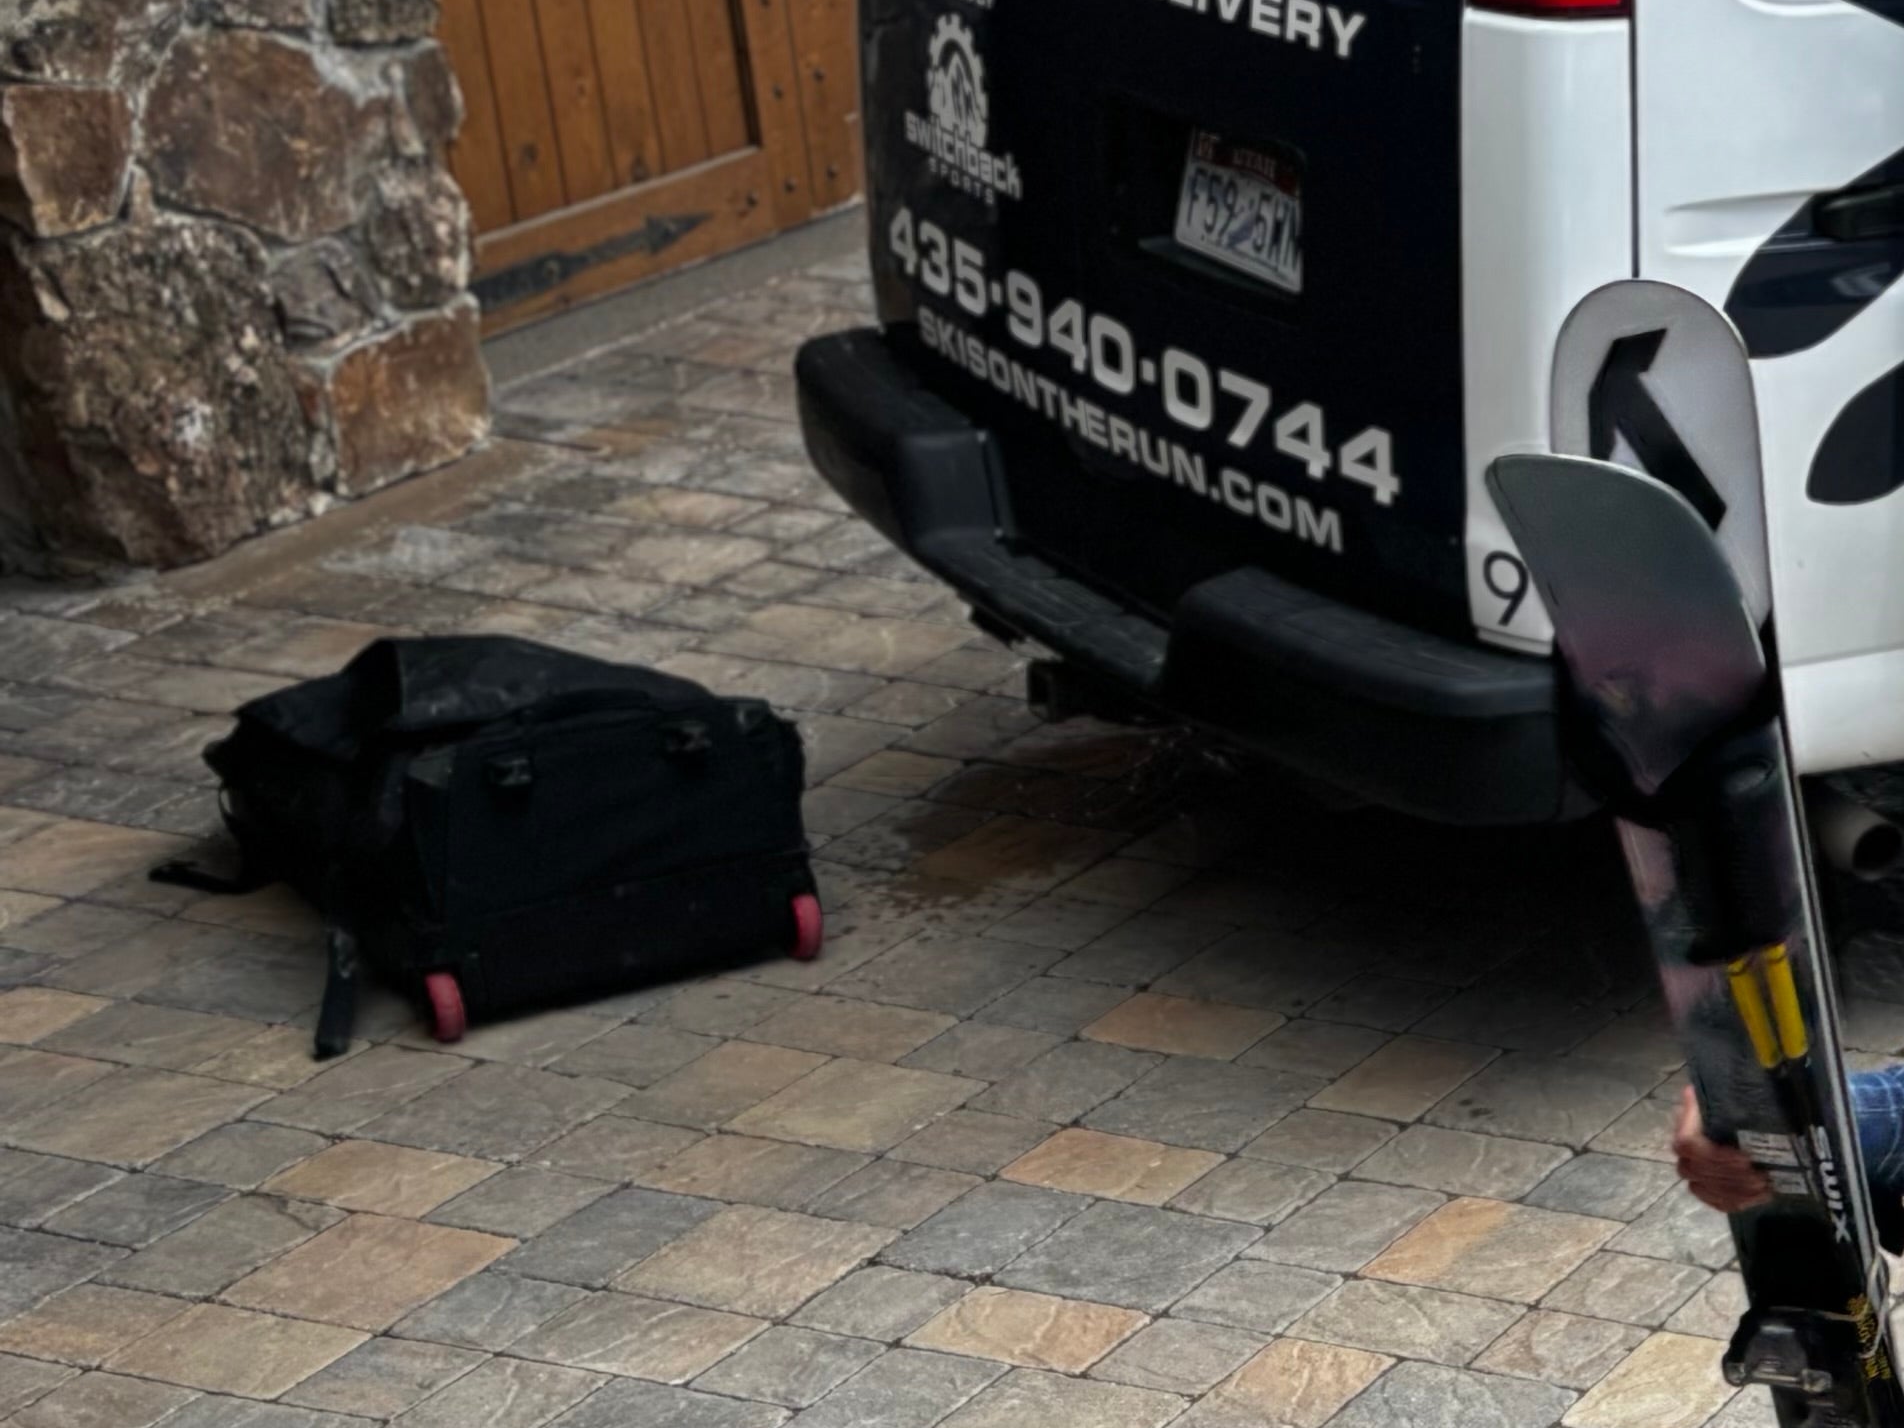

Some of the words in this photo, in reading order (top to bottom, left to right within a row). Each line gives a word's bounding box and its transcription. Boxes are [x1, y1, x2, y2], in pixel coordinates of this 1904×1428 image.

[928, 157, 996, 206] SPORTS
[916, 304, 1344, 554] SKISONTHERUN.COM
[1482, 550, 1529, 627] 9
